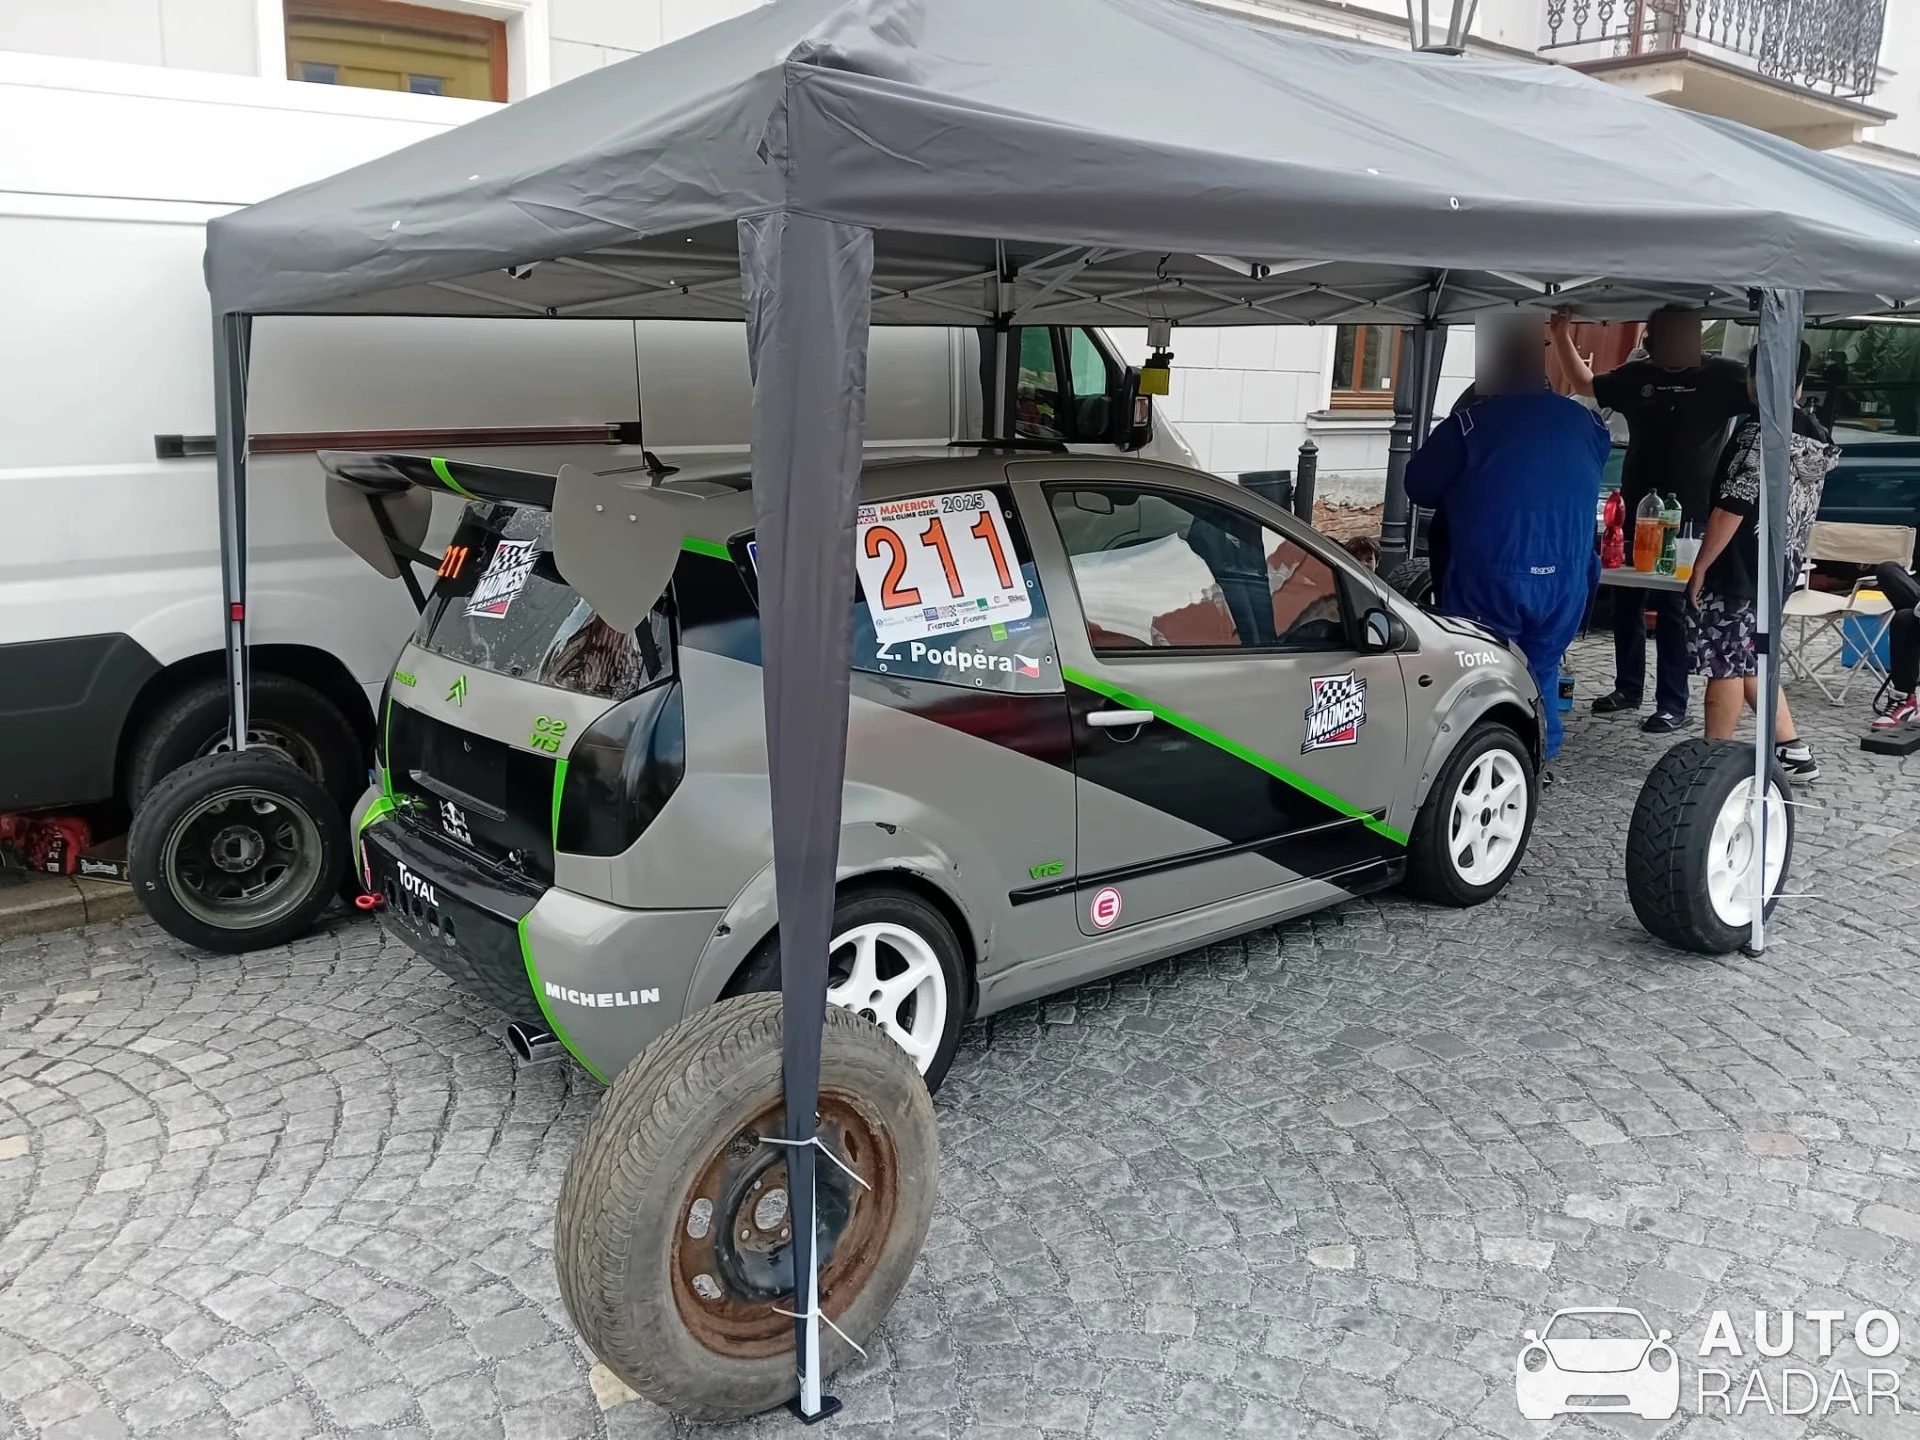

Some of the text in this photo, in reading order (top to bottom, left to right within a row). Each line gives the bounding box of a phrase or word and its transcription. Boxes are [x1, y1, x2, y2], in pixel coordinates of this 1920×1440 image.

[880, 493, 985, 515] MAVERICK 2025
[881, 509, 939, 522] HILL CLIMB CZECH
[437, 544, 469, 579] 211
[864, 511, 1014, 611] 211
[470, 562, 532, 604] MADNESS
[911, 642, 1013, 673] Podpěra
[533, 715, 568, 739] C2
[1307, 691, 1366, 743] MADNESS
[528, 733, 561, 753] VTS
[1318, 723, 1354, 744] RACING
[1029, 861, 1065, 880] VTS
[545, 981, 661, 1009] MICHELIN
